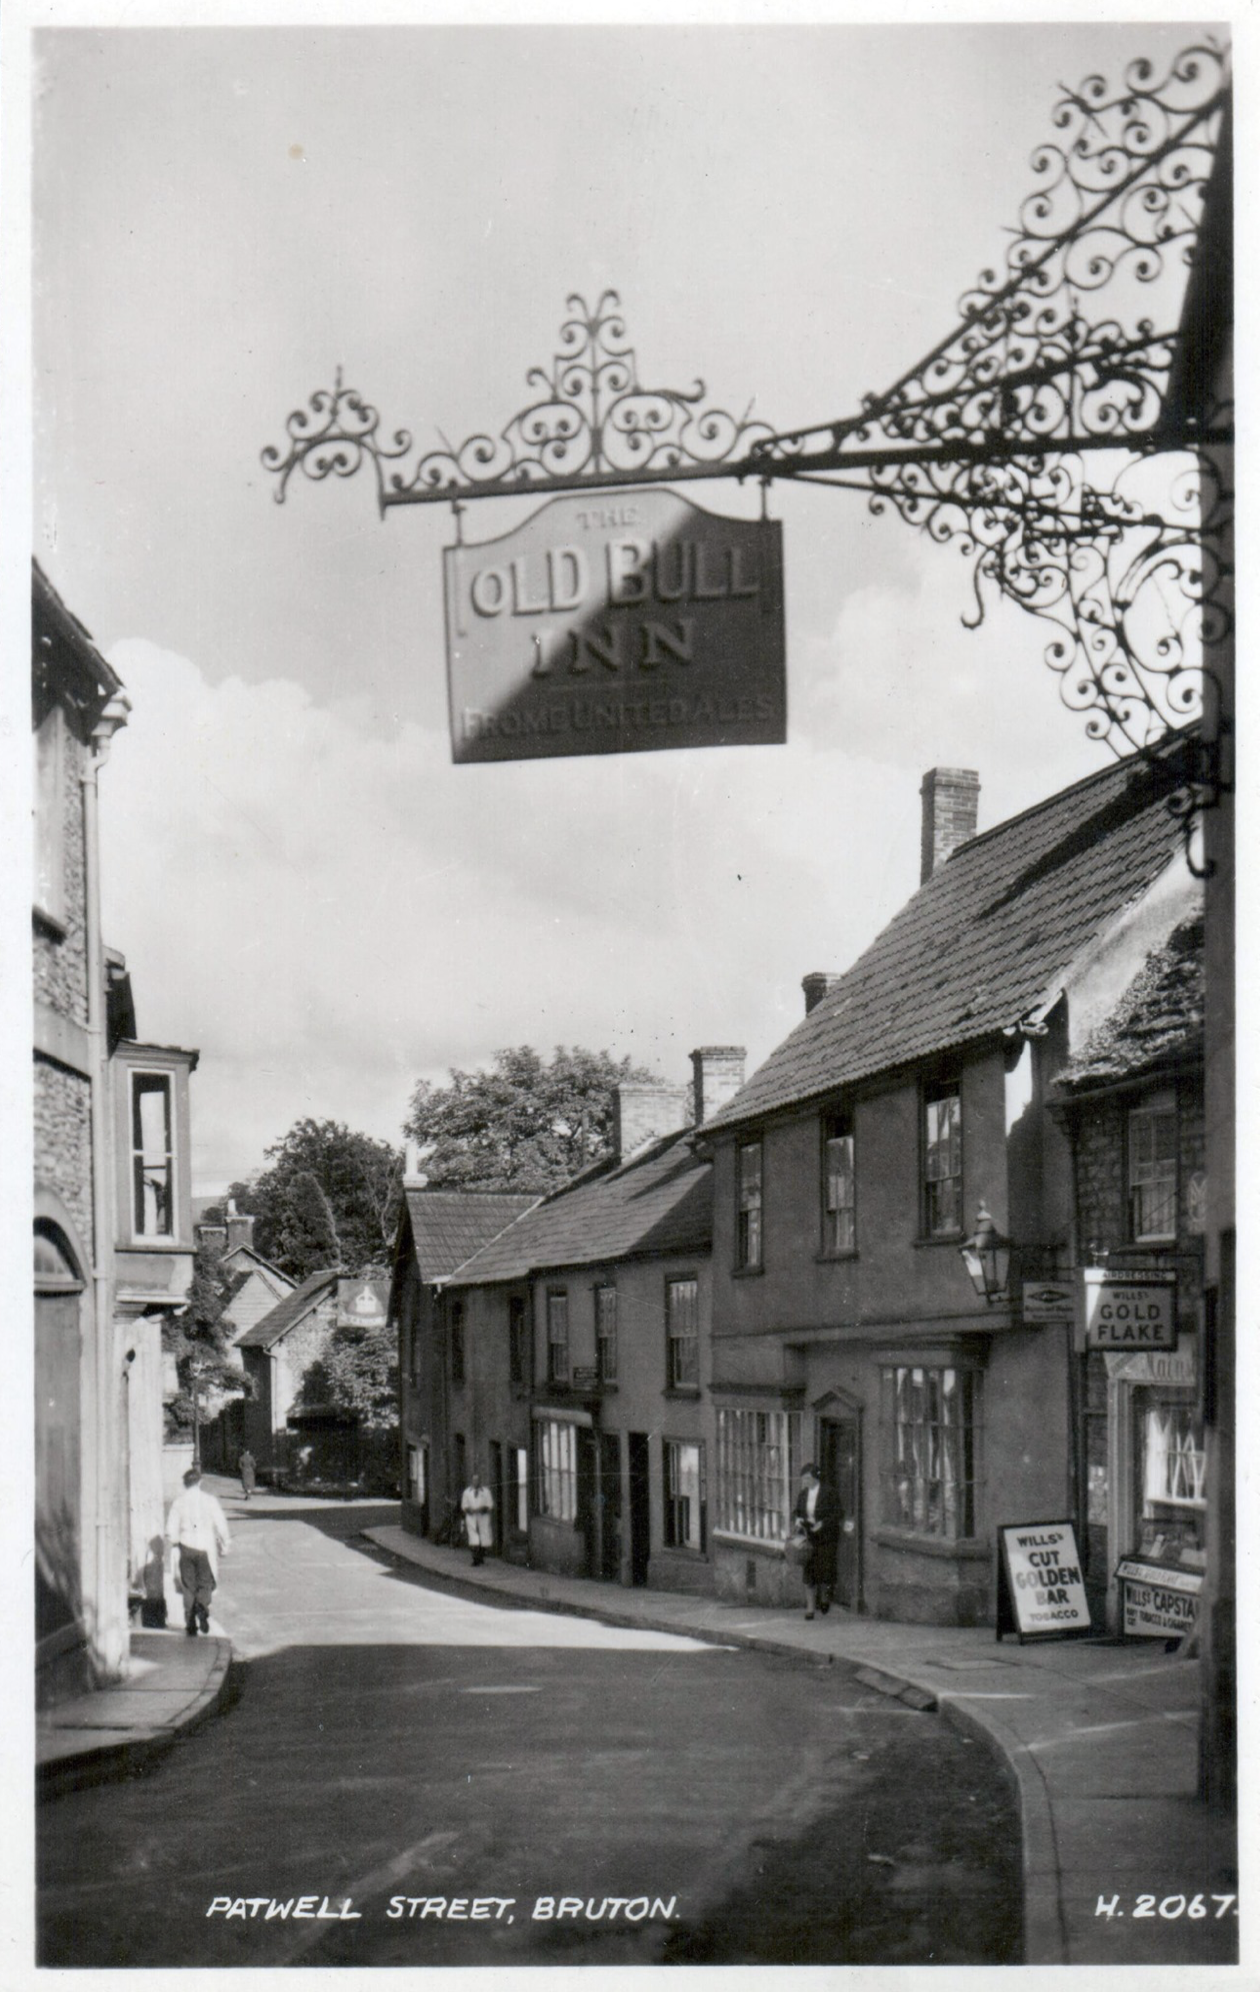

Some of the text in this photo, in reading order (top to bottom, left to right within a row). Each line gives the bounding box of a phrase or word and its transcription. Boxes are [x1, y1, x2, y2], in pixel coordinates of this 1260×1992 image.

[576, 506, 640, 531] THE
[470, 538, 761, 619] OLD BULL
[531, 617, 696, 679] INN
[569, 697, 688, 732] UNITED
[692, 693, 775, 725] ALES
[1100, 1303, 1160, 1320] GOLD
[1097, 1323, 1164, 1341] FLAKE
[1028, 1551, 1061, 1567] CUT
[1015, 1566, 1082, 1590] GOLDEN
[1036, 1588, 1071, 1606] BAR
[1029, 1609, 1079, 1623] TOBACCO
